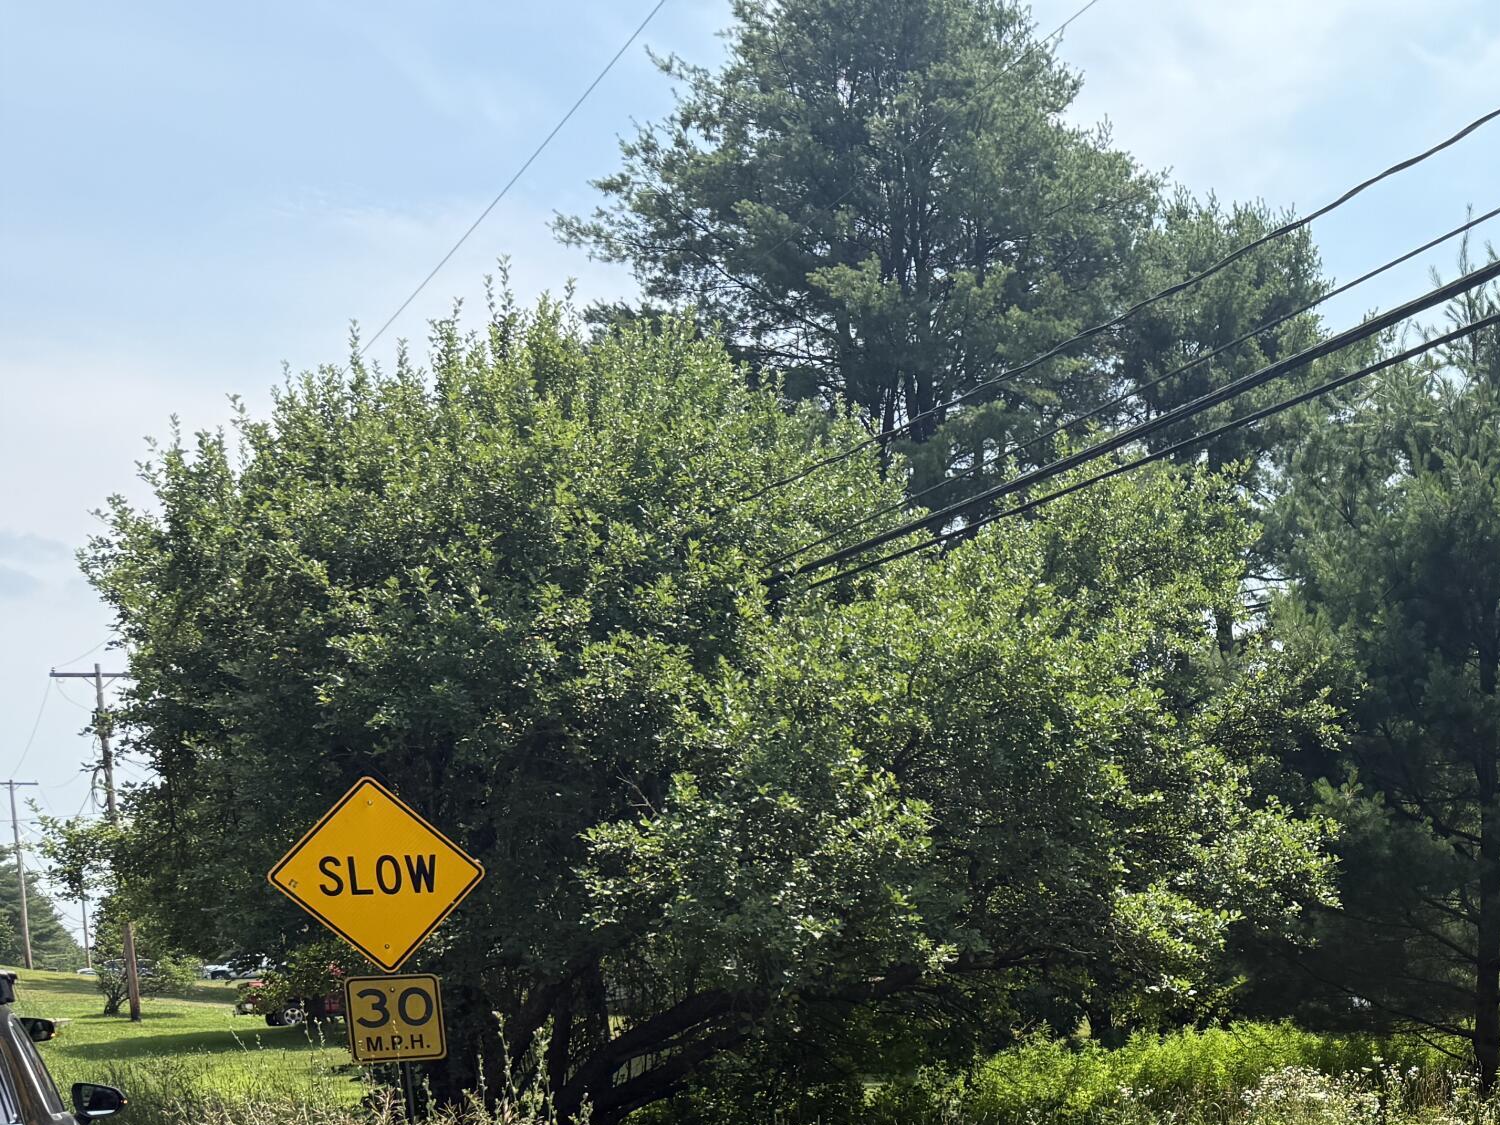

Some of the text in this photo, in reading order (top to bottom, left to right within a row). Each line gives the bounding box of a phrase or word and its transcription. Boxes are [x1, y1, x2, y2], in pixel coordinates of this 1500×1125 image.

[318, 854, 436, 897] SLOW
[356, 987, 434, 1028] 30
[366, 1034, 431, 1052] M.P.H.
